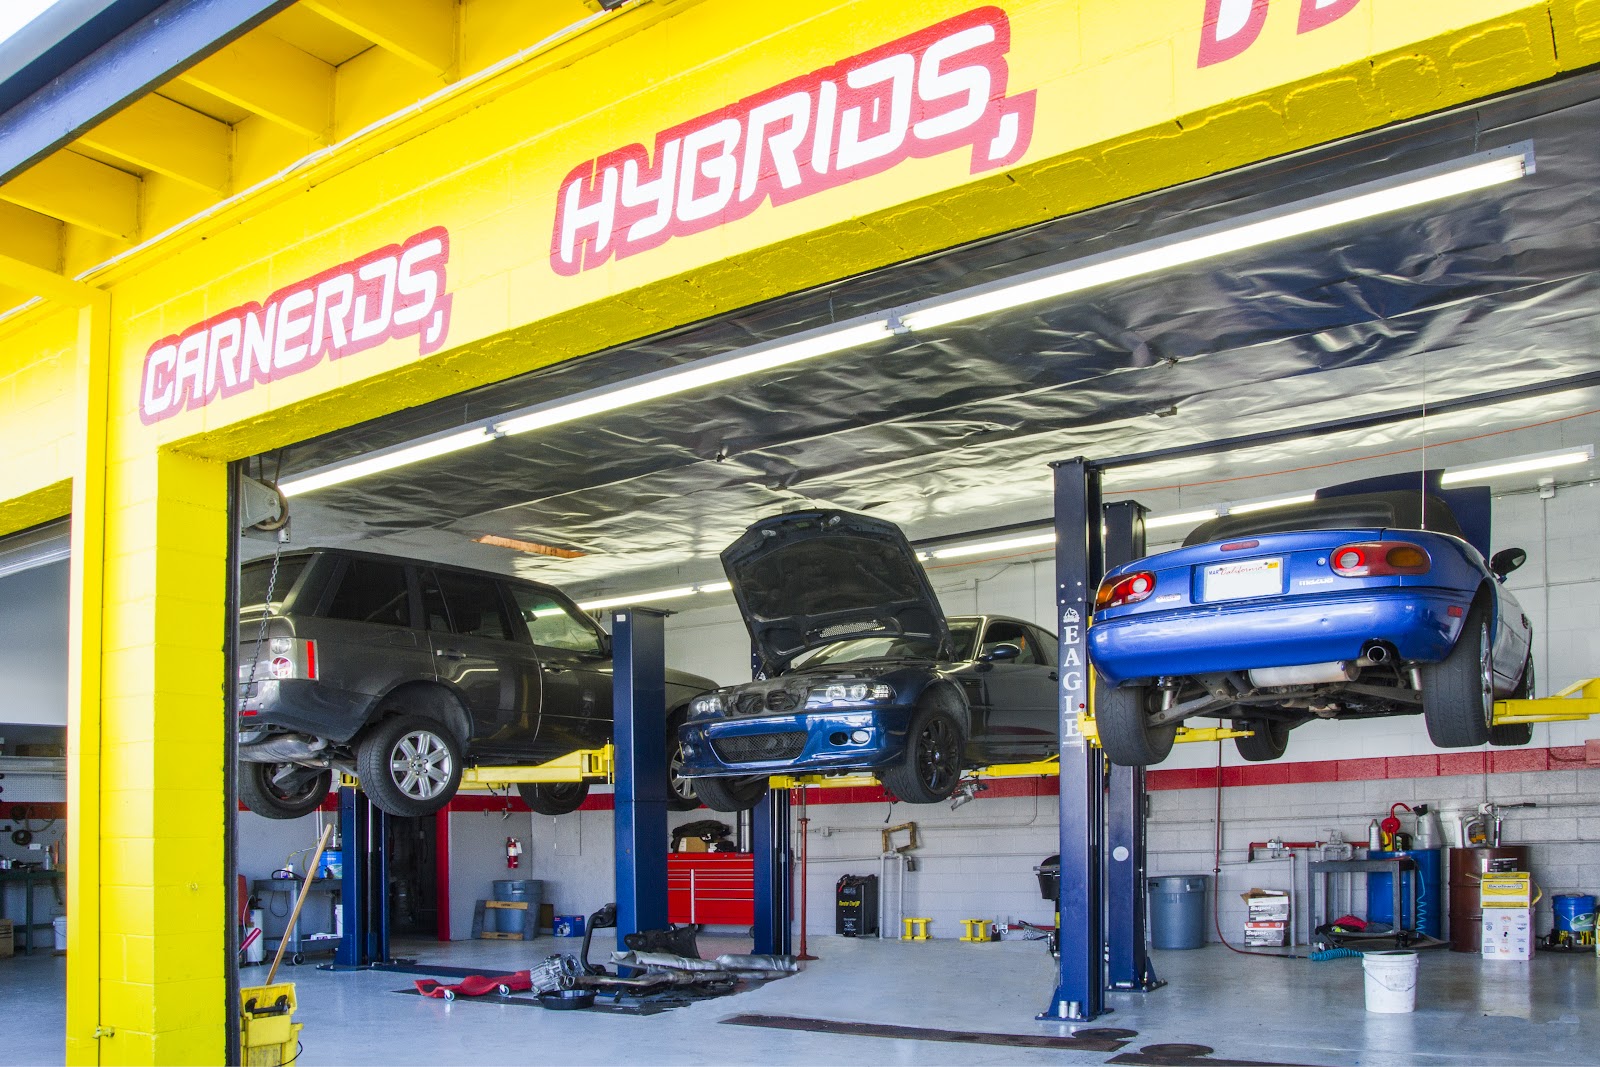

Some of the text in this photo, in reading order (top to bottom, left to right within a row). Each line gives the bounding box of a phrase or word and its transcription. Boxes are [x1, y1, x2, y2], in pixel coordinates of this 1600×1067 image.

[555, 15, 1028, 269] HYBRIDS,
[141, 233, 447, 420] CARNERDS,
[1220, 565, 1263, 576] California
[1299, 577, 1334, 585] mazda
[1063, 625, 1082, 737] EAGLE
